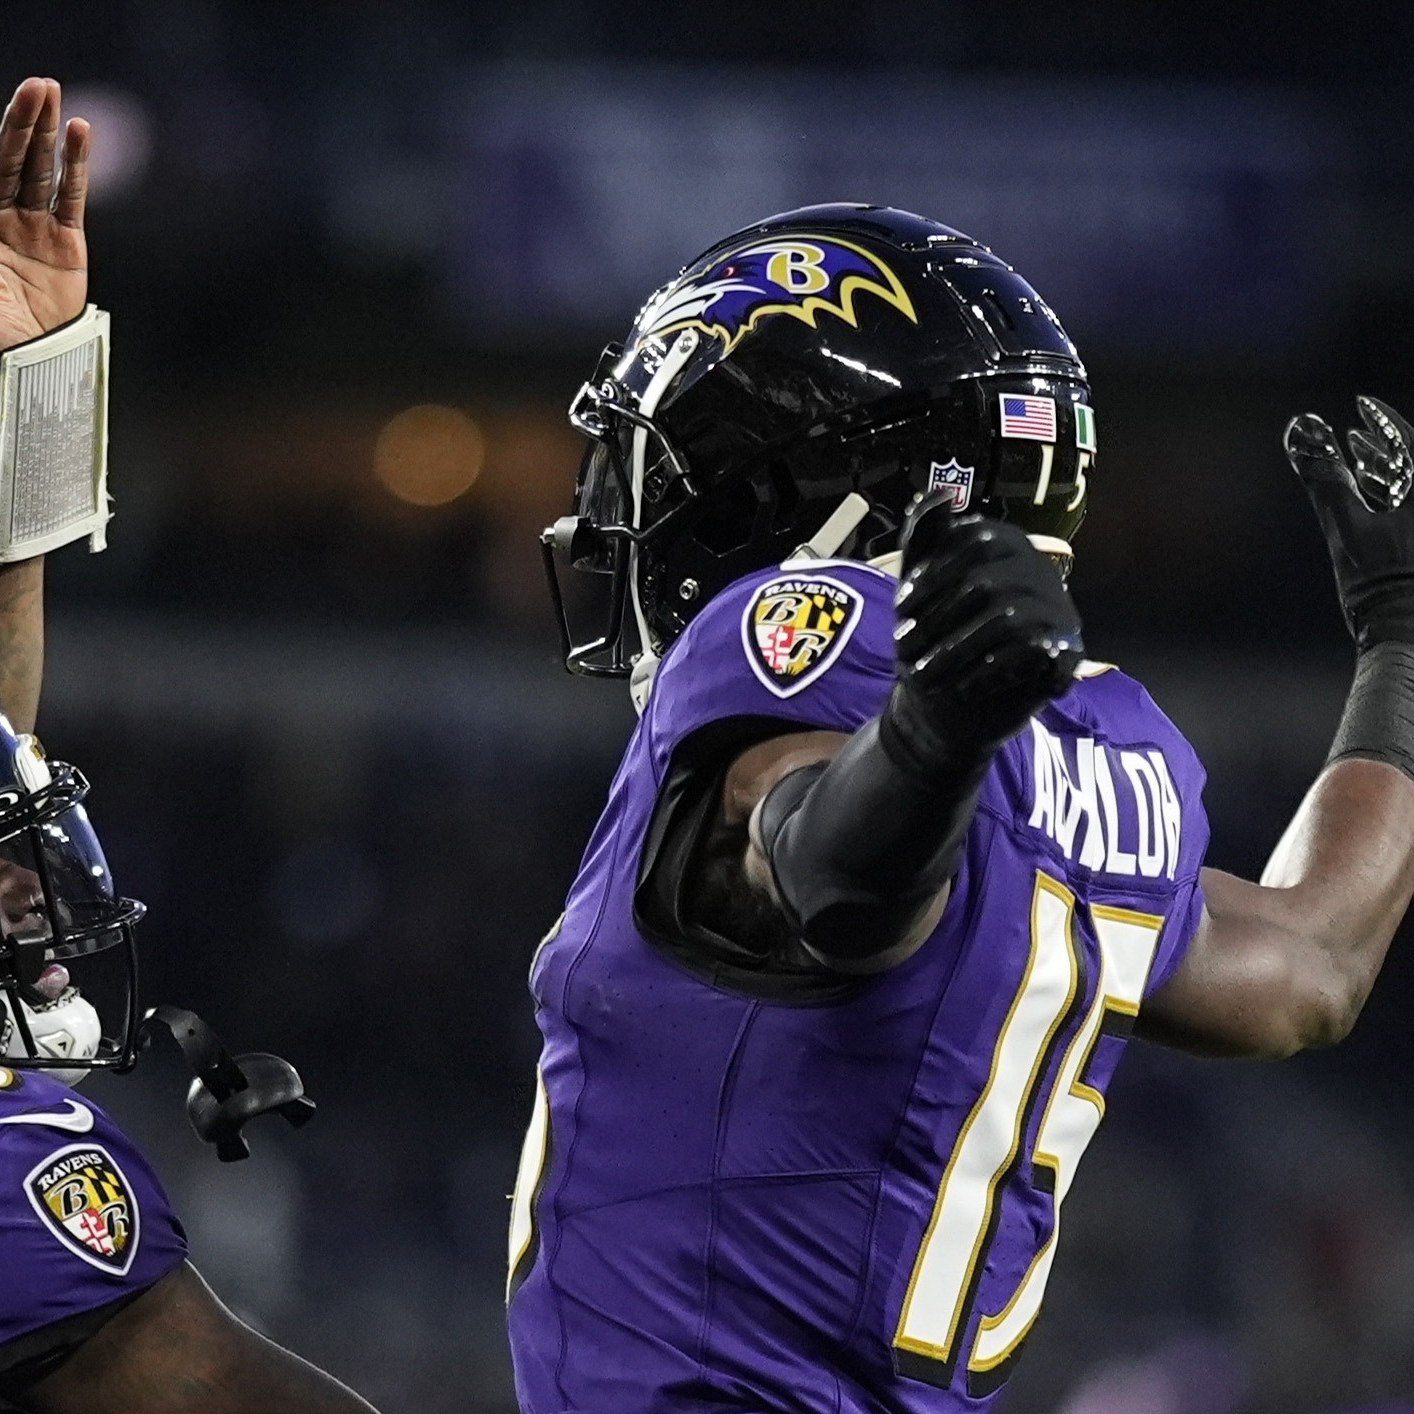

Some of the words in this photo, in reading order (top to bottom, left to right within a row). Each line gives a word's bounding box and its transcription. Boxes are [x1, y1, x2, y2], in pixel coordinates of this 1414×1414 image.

[753, 242, 830, 294] B
[765, 582, 848, 604] RAVENS
[893, 868, 1165, 1375] 15
[37, 1152, 104, 1192] RAVENS
